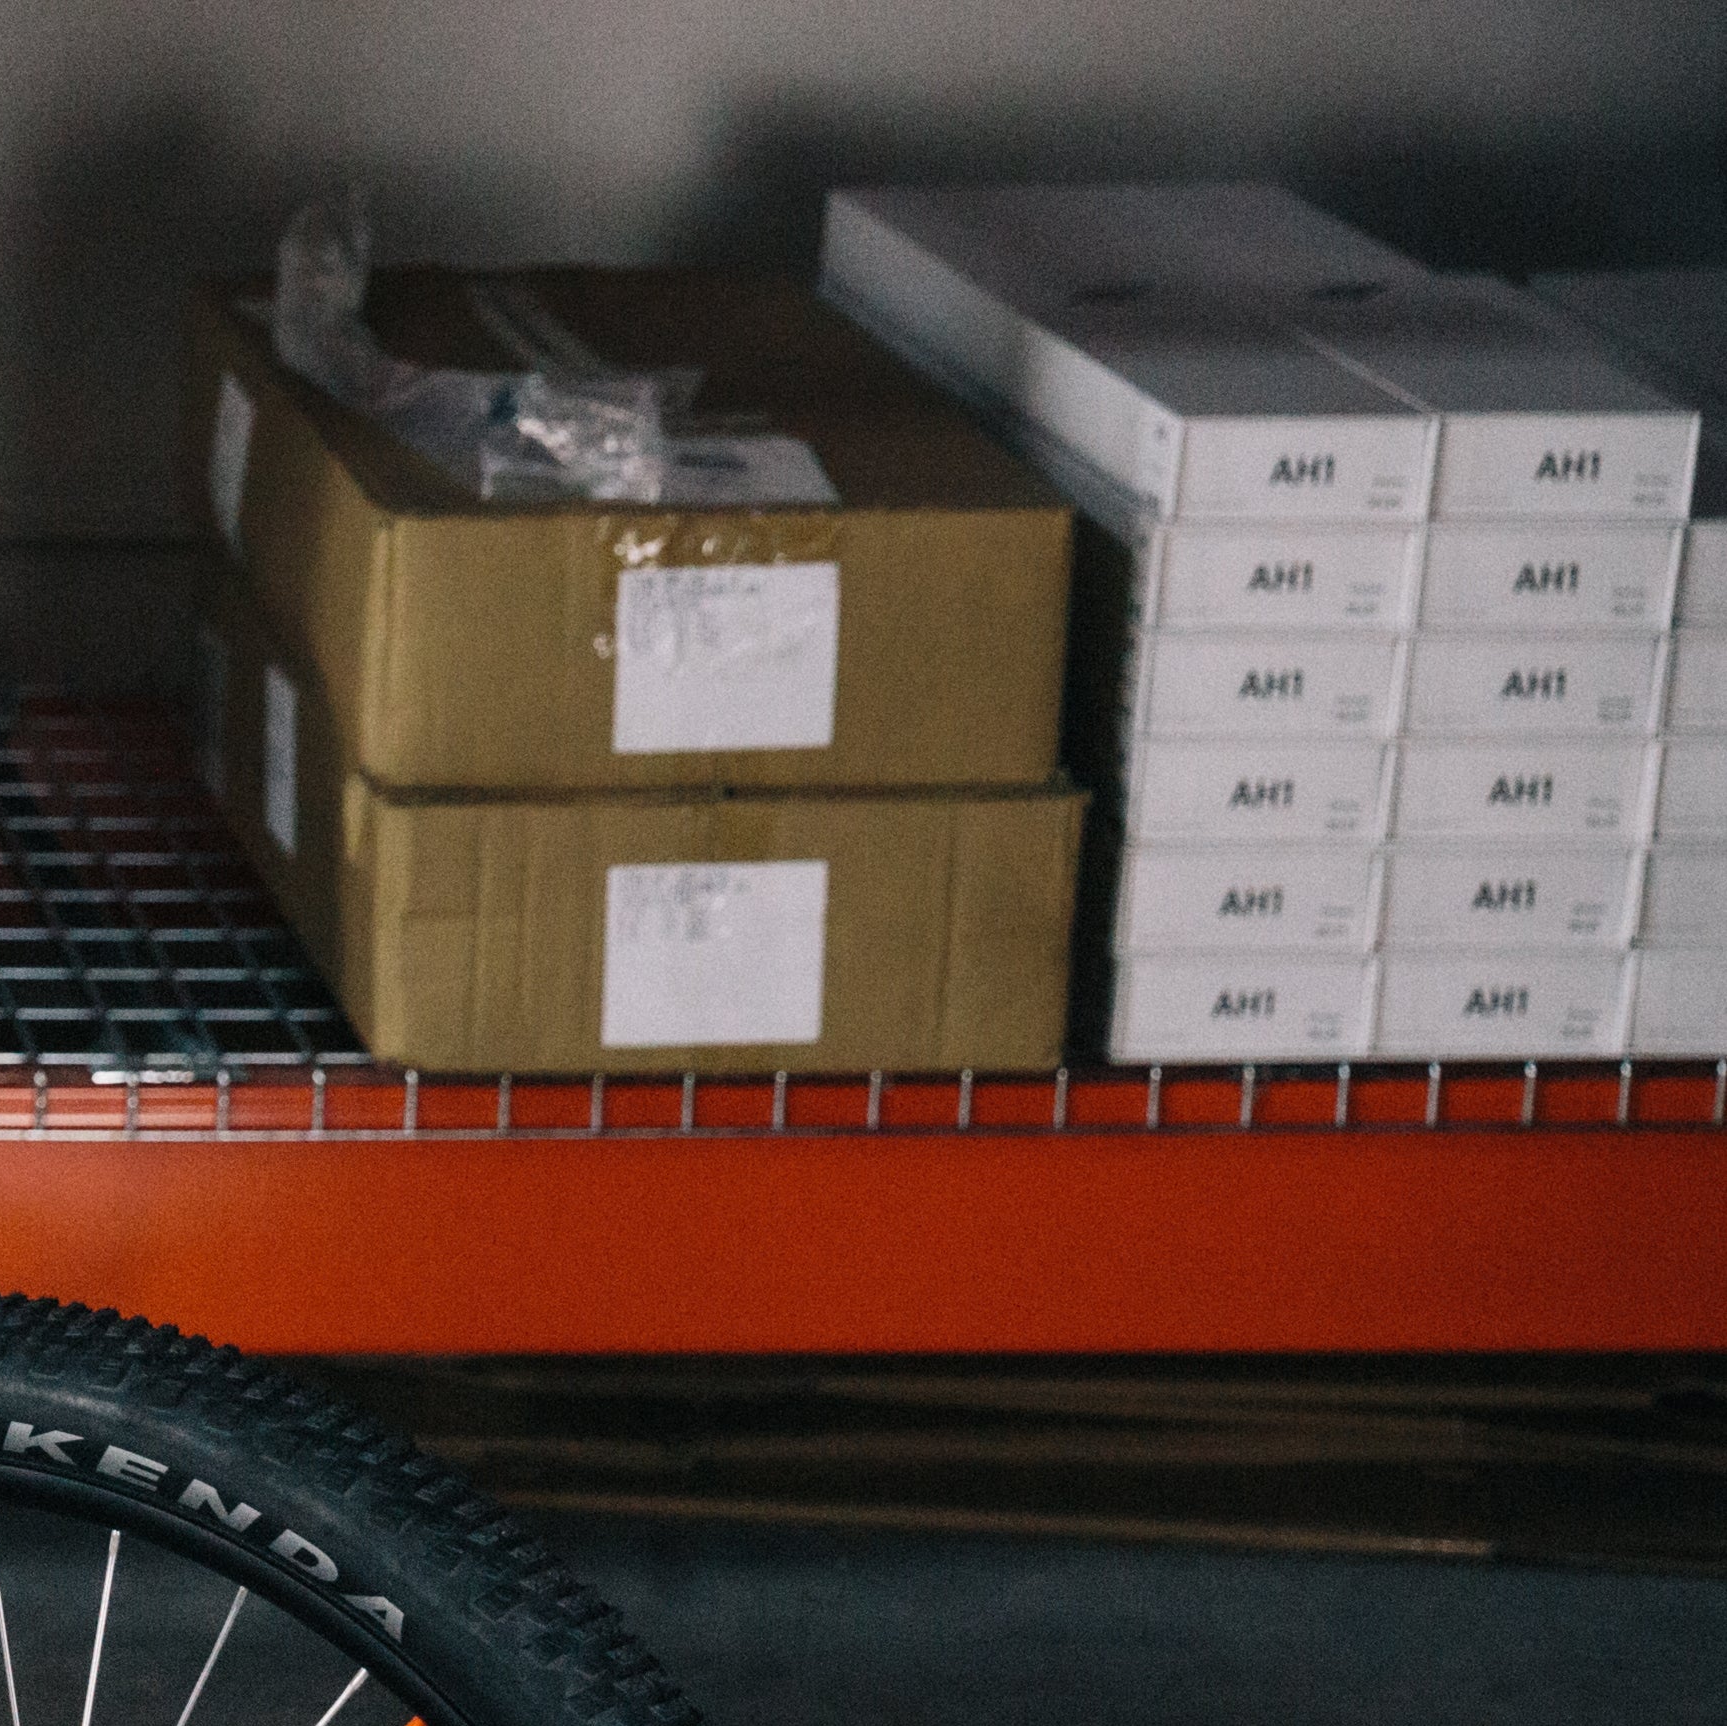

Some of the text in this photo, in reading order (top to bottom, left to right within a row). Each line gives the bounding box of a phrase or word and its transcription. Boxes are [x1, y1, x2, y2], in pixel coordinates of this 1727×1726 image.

[1270, 455, 1336, 485] AH1
[1534, 451, 1601, 481] AH1
[1248, 562, 1314, 592] AH1
[1513, 563, 1579, 594] AH1
[1239, 669, 1304, 699] AH1
[1500, 669, 1566, 699] AH1
[1230, 780, 1294, 808] AH1
[1487, 776, 1553, 806] AH1
[1219, 887, 1284, 917] AH1
[1471, 881, 1537, 910] AH1
[1212, 989, 1276, 1018] AH1
[1463, 989, 1530, 1018] AH1
[3, 1421, 404, 1643] KENDA
